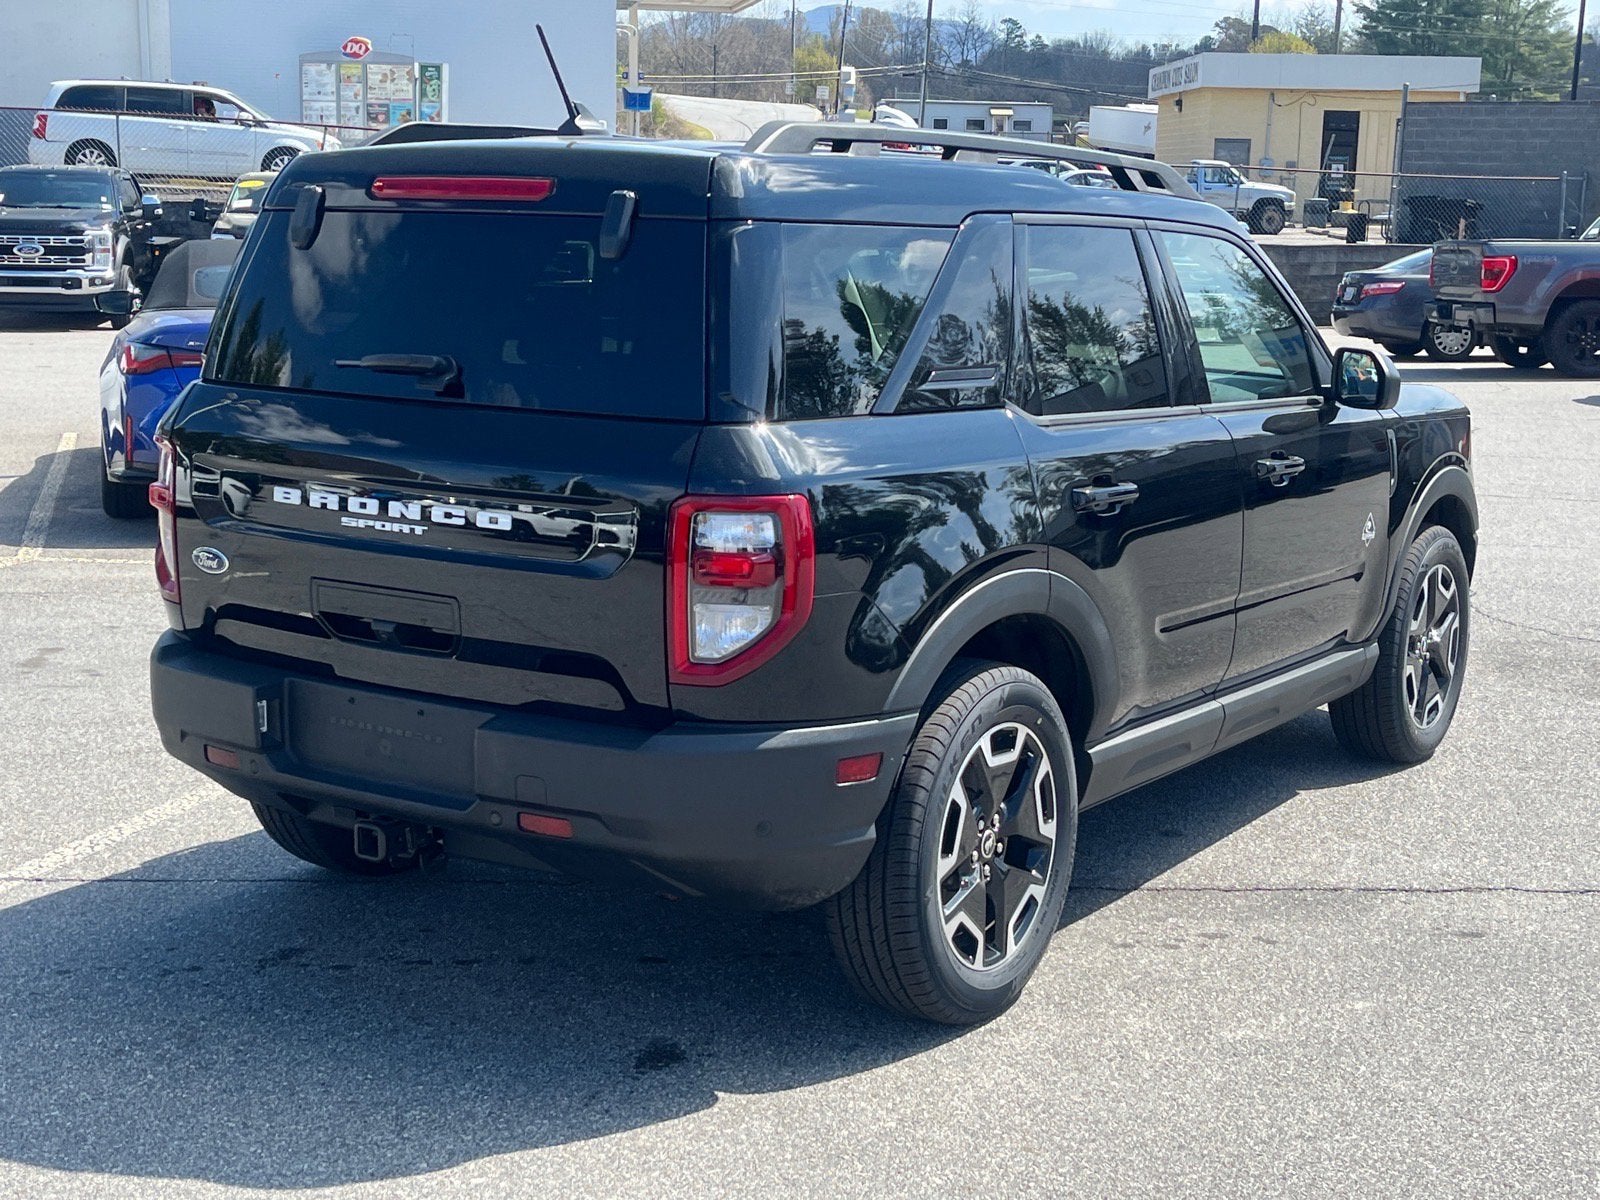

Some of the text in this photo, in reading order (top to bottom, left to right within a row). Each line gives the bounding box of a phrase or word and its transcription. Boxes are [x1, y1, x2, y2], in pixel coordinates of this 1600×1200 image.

[346, 41, 366, 56] DQ
[273, 485, 513, 531] BRONCO
[340, 516, 429, 536] SPORT
[197, 551, 219, 569] Ford
